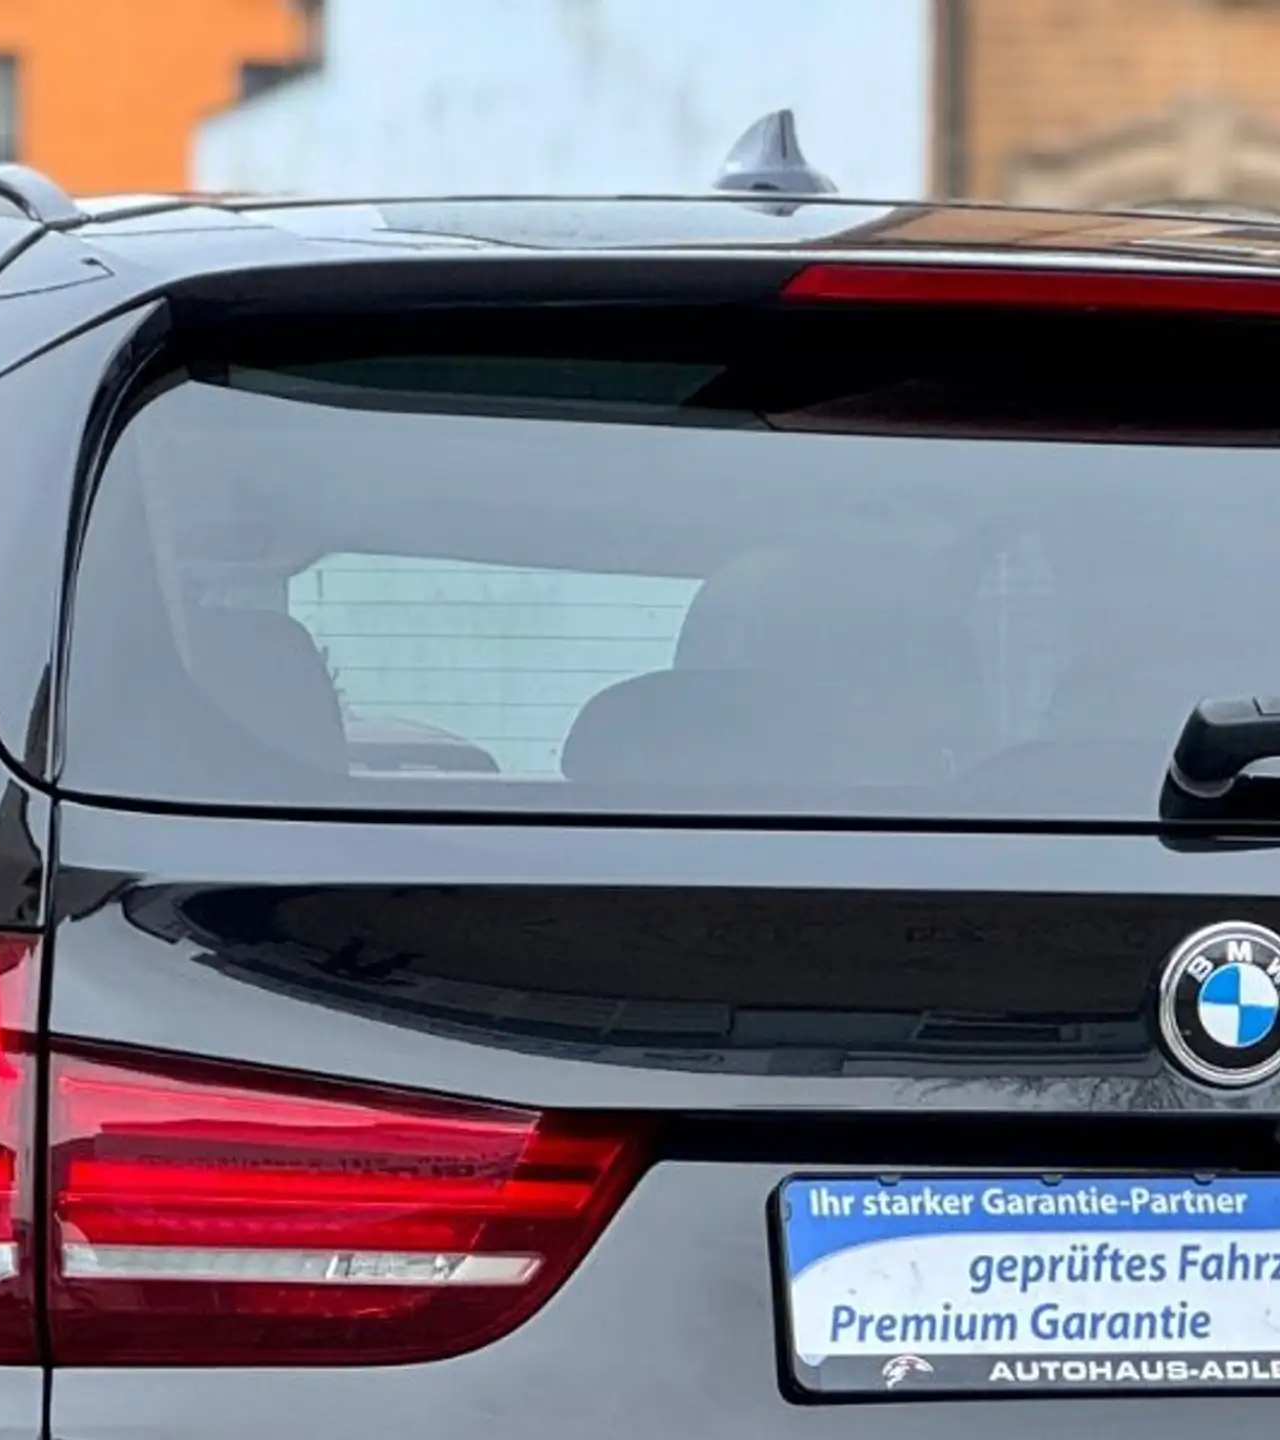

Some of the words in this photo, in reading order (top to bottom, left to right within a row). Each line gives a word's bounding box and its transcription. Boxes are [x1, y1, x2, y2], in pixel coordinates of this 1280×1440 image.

[809, 1187, 855, 1217] Ihr
[862, 1187, 975, 1216] starker
[981, 1186, 1249, 1216] Garantie-Partner
[968, 1243, 1168, 1294] geprüftes
[829, 1302, 1018, 1343] Premium
[1030, 1300, 1211, 1341] Garantie
